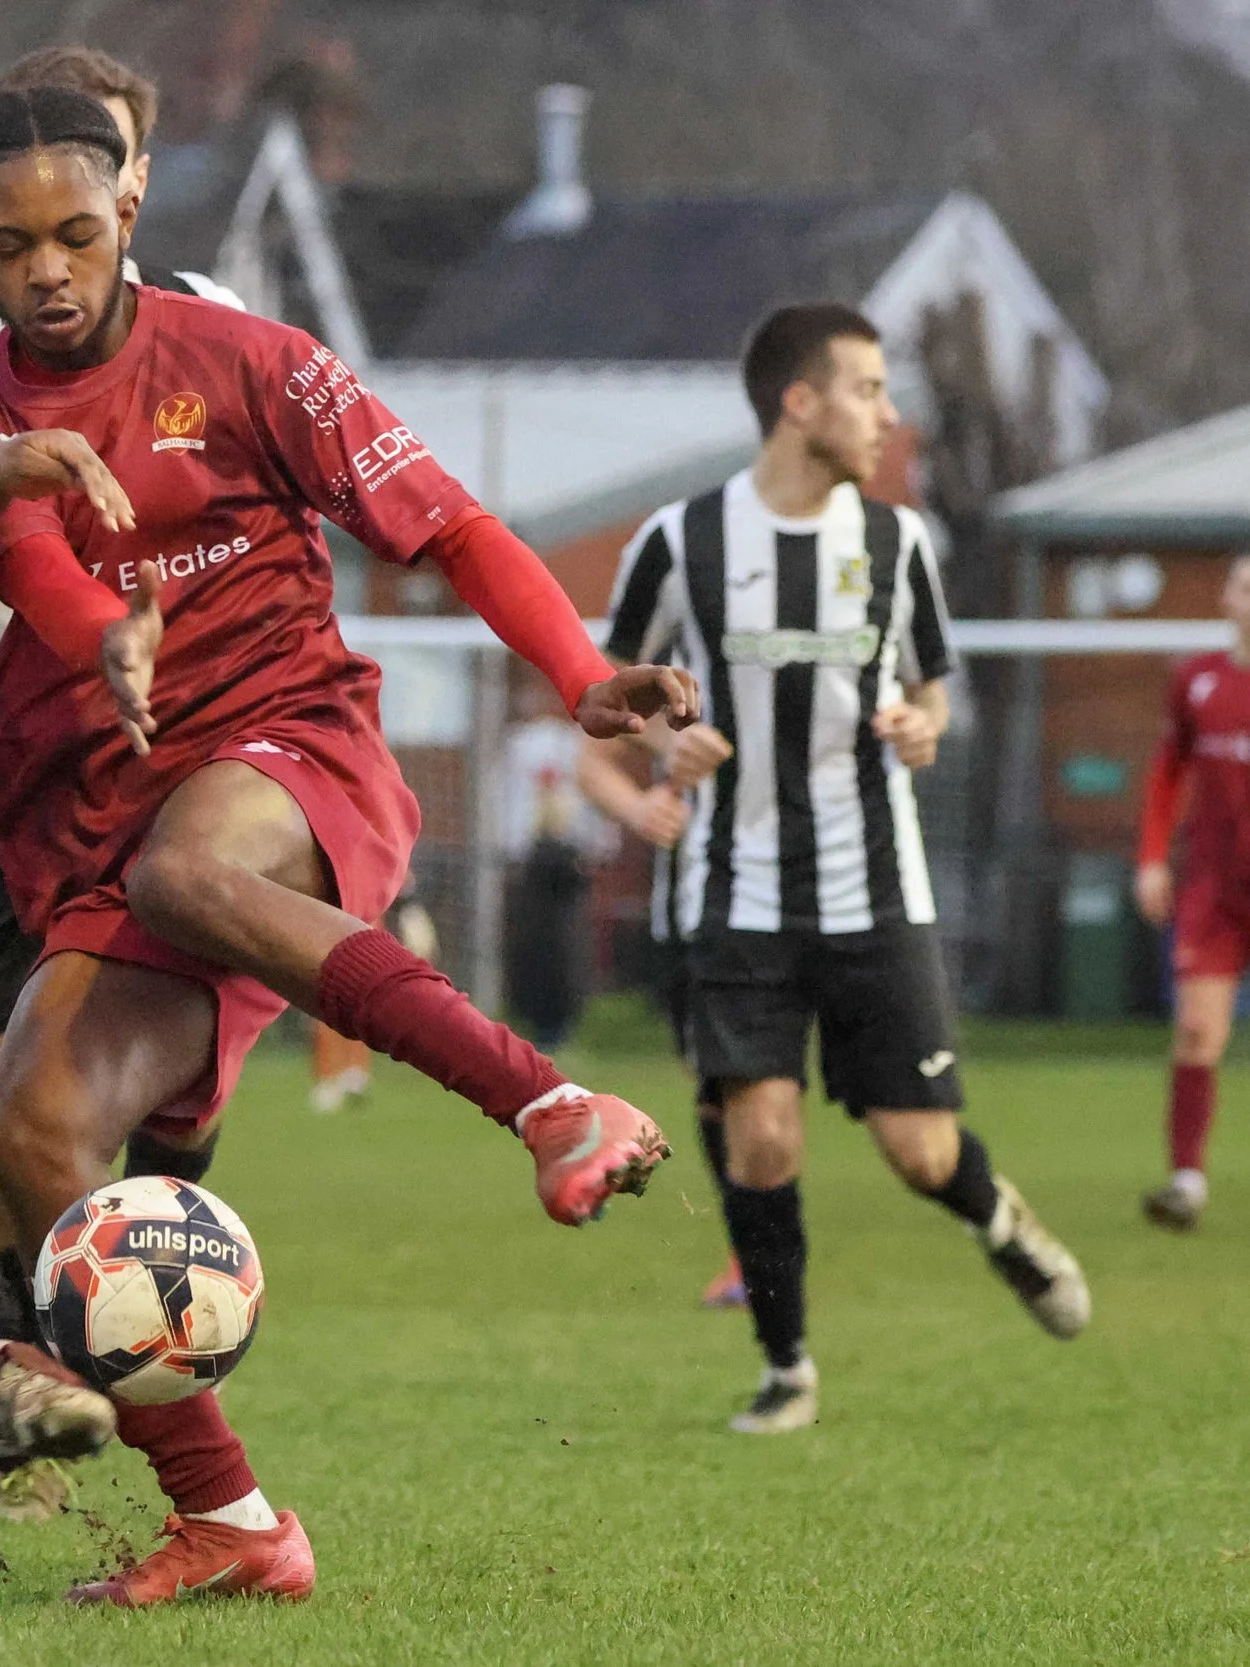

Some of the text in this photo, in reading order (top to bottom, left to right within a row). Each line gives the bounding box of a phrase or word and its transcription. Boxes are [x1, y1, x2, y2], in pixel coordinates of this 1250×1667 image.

[352, 426, 421, 481] EDR
[118, 536, 251, 591] Etates
[128, 1225, 240, 1267] uhlsport
